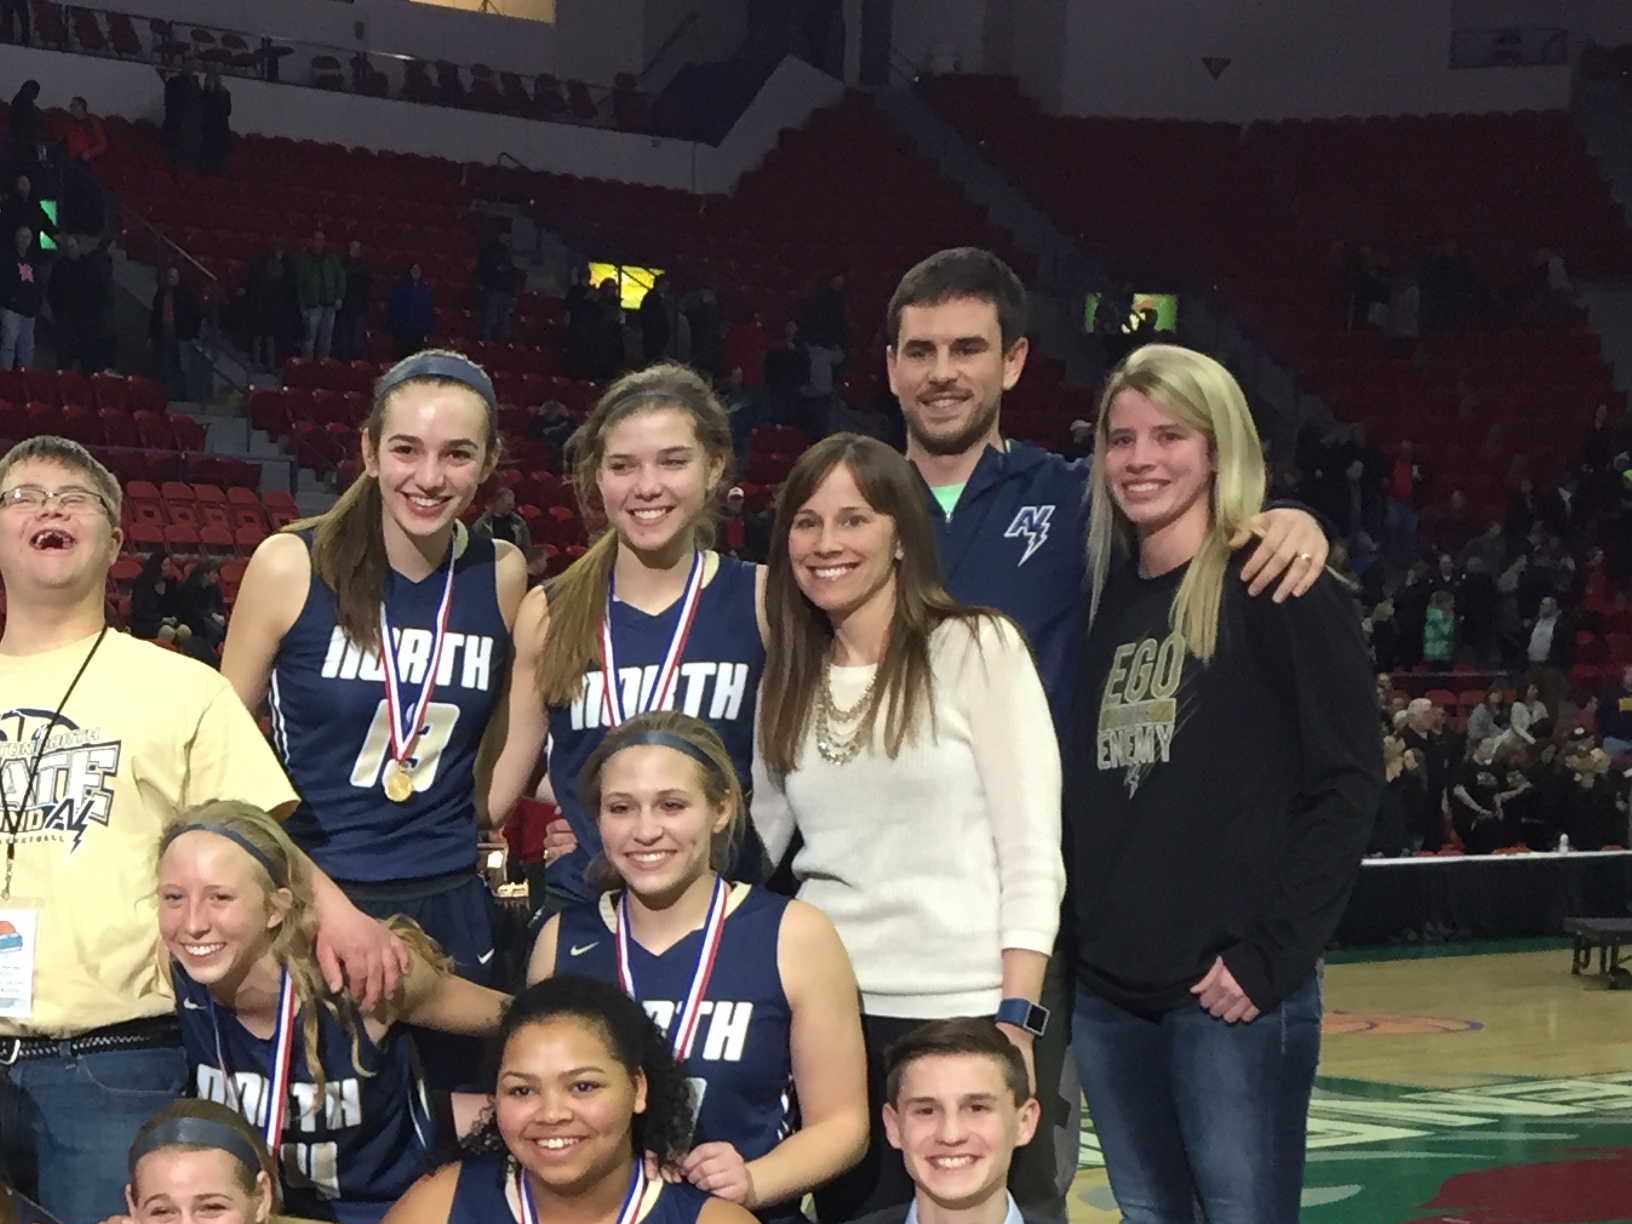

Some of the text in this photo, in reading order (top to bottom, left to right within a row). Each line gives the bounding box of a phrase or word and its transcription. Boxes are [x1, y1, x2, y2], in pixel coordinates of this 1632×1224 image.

[1102, 634, 1186, 706] EGO
[349, 698, 461, 793] 13
[1097, 720, 1175, 771] ENEMY
